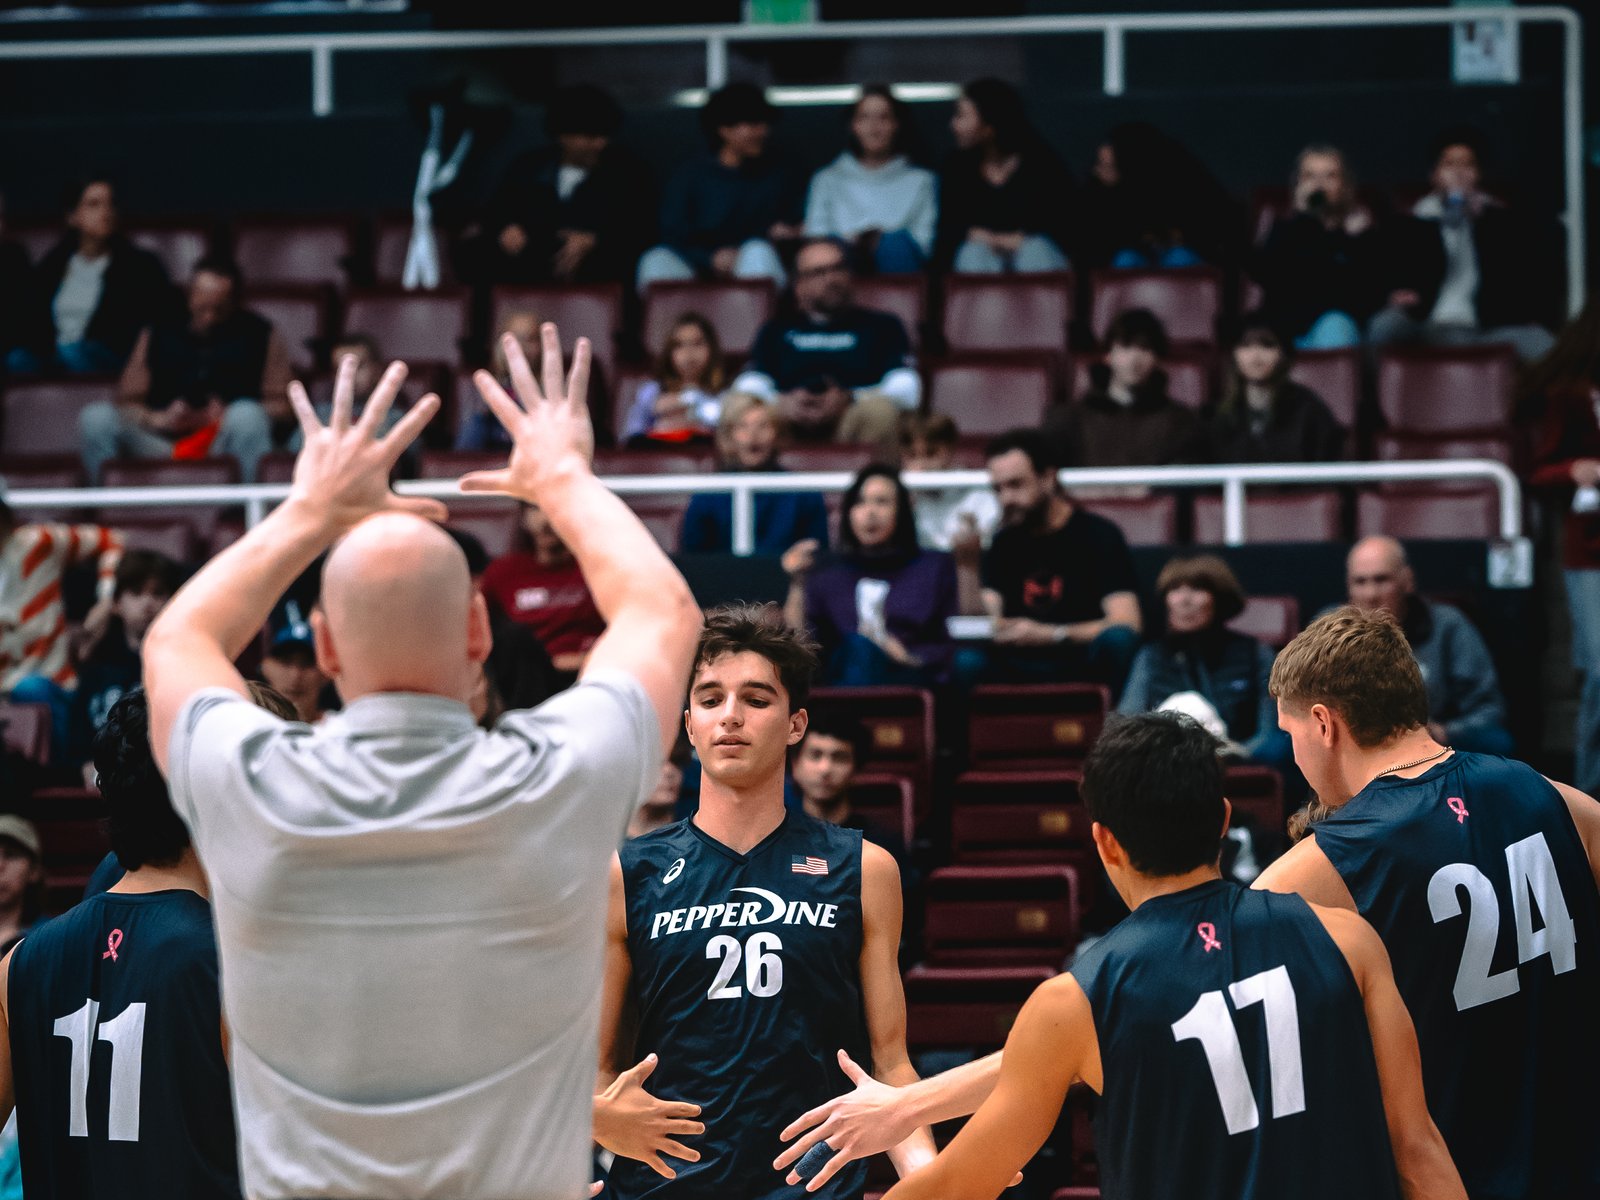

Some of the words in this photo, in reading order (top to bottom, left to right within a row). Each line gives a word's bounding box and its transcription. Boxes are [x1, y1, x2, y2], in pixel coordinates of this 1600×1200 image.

[650, 887, 838, 939] PEPPERDINE
[706, 931, 783, 1000] 26
[1427, 831, 1577, 1011] 24
[53, 997, 147, 1142] 11
[1171, 964, 1306, 1136] 17
